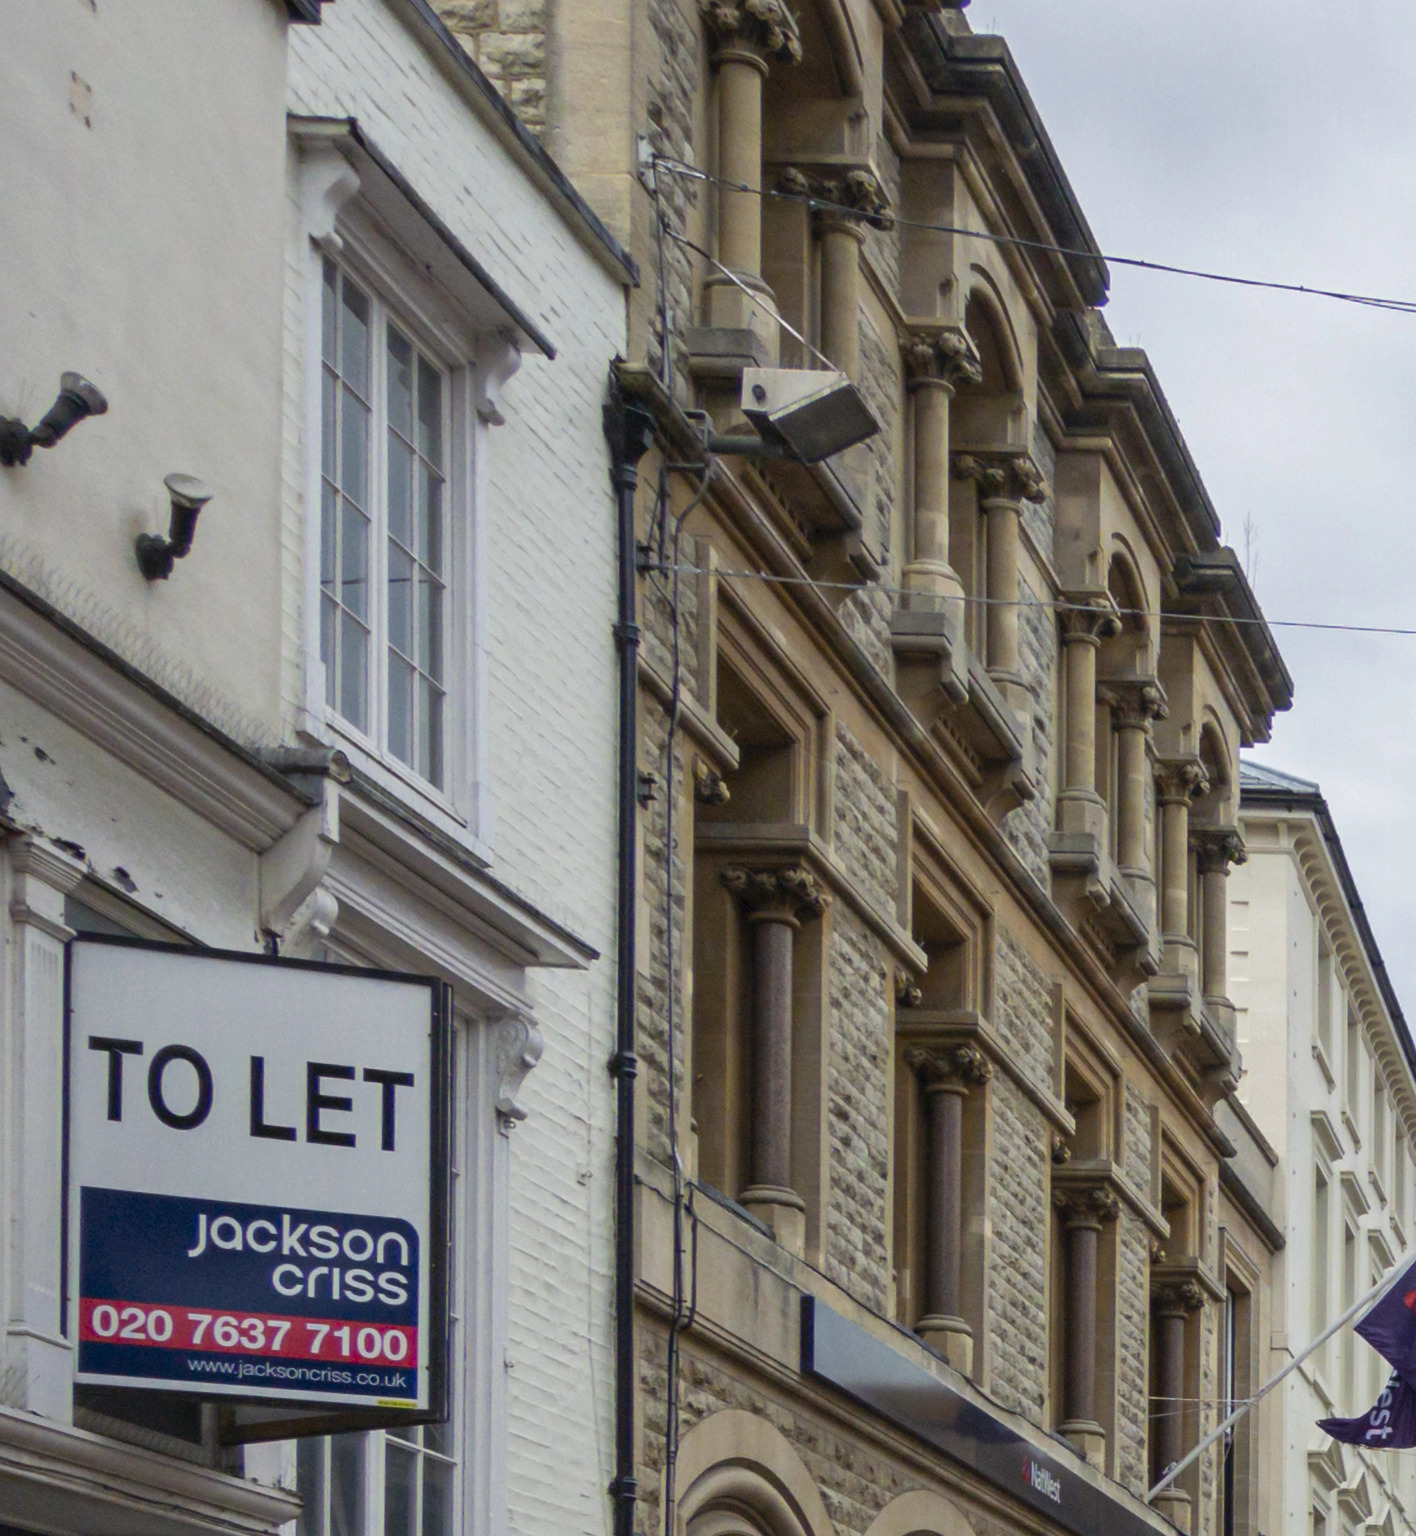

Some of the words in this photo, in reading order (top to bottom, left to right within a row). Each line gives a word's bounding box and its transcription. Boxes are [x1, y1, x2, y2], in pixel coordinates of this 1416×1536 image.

[87, 1035, 214, 1131] TO
[248, 1055, 415, 1152] LET
[188, 1213, 410, 1266] jackson
[271, 1263, 409, 1305] criss
[91, 1304, 174, 1344] 020
[188, 1313, 292, 1354] 7637
[305, 1322, 408, 1362] 7100
[187, 1357, 408, 1389] www.jacksoncriss.co.uk
[1030, 1460, 1061, 1504] NatWest
